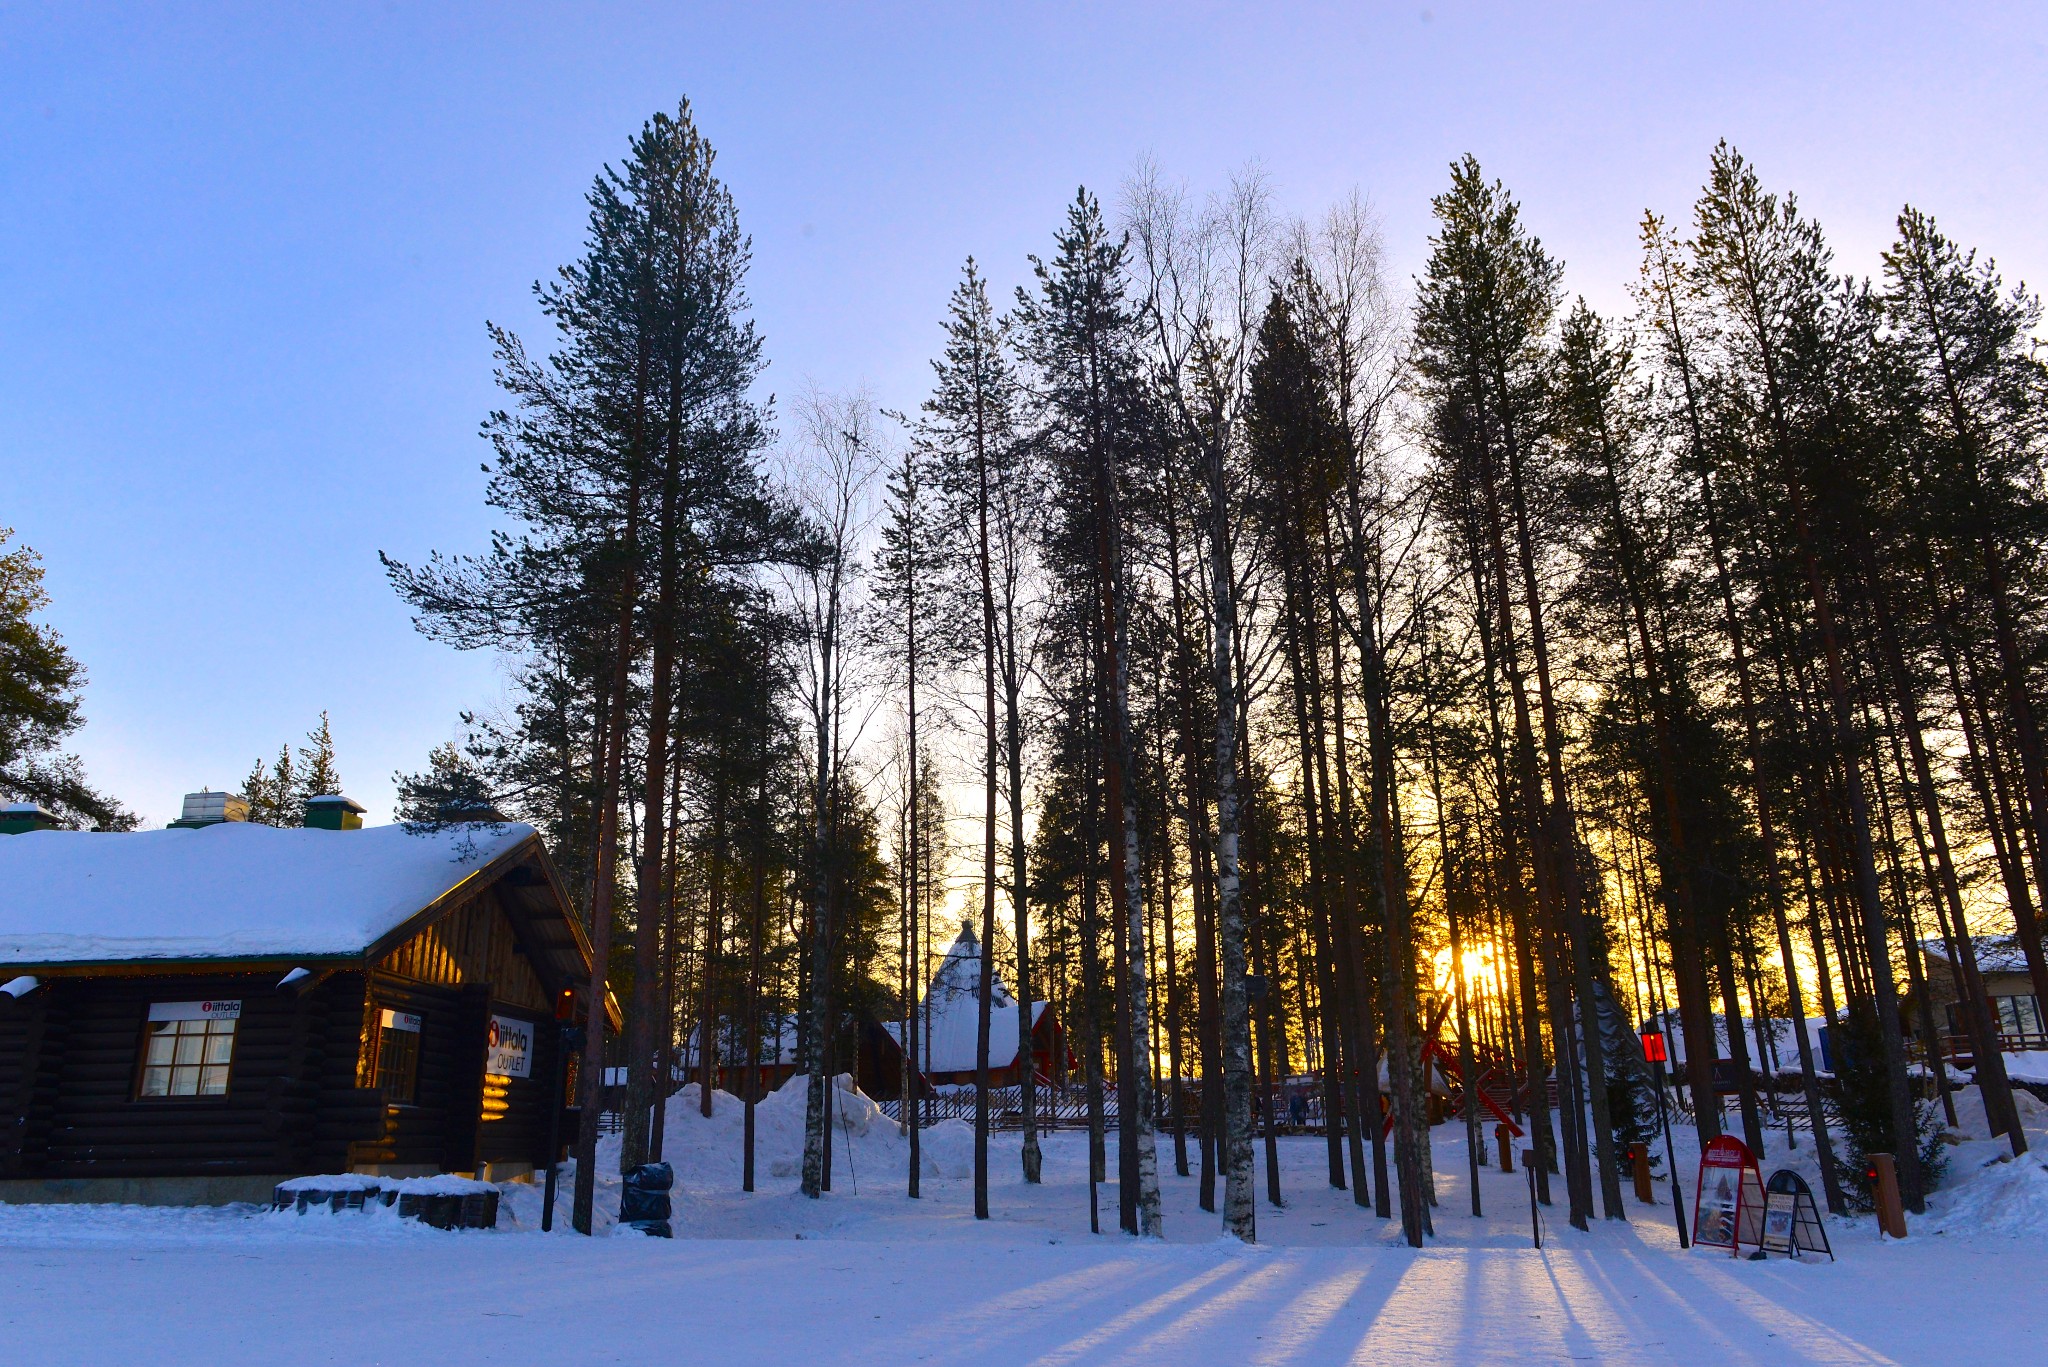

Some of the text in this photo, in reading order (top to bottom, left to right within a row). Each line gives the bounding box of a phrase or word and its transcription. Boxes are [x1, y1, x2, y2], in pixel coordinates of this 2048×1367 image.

[212, 1002, 240, 1012] iittala
[211, 1011, 238, 1019] OUTLET
[499, 1024, 527, 1052] iittala
[497, 1053, 525, 1072] OUTLET
